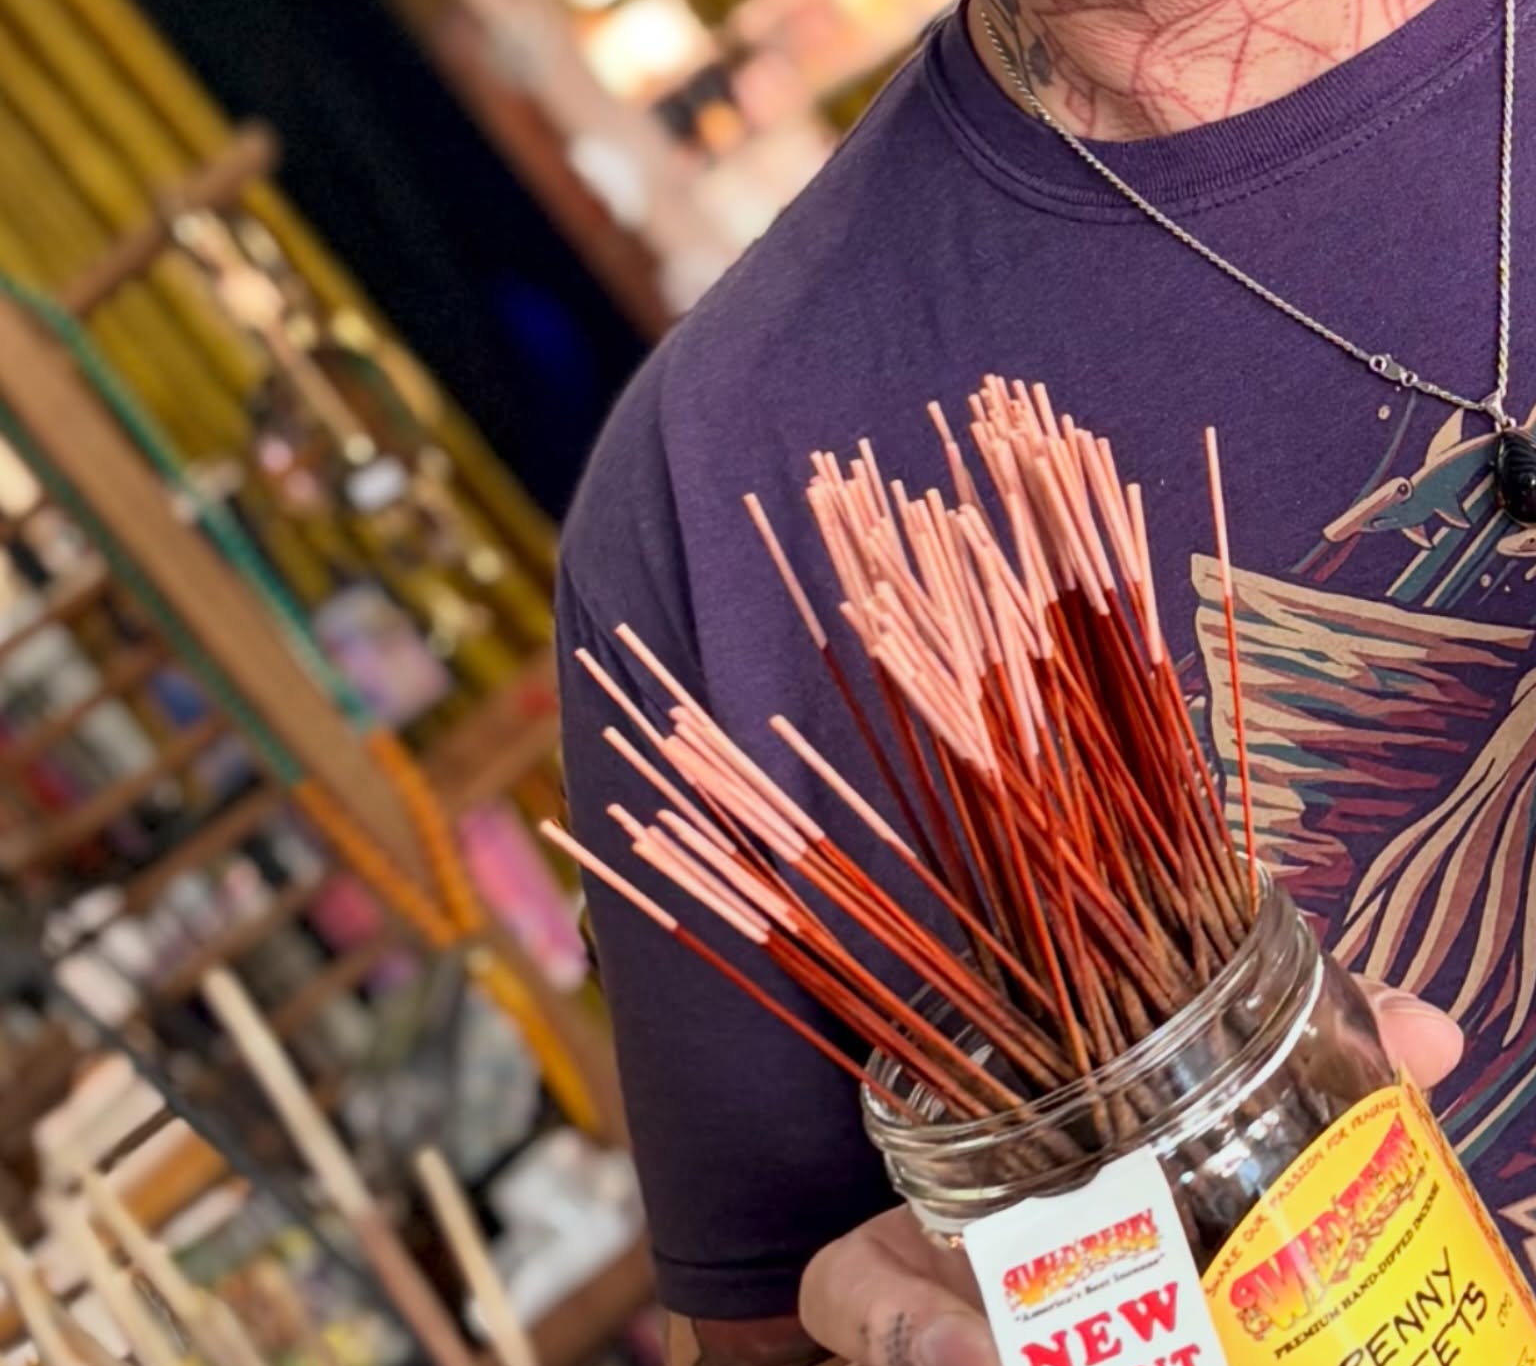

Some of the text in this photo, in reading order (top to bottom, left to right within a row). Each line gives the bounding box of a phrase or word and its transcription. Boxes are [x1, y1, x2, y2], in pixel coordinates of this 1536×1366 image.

[1229, 1210, 1352, 1335] WILD
[1274, 1306, 1341, 1360] PREMIUM
[1340, 1229, 1414, 1310] HAND-DIPPED
